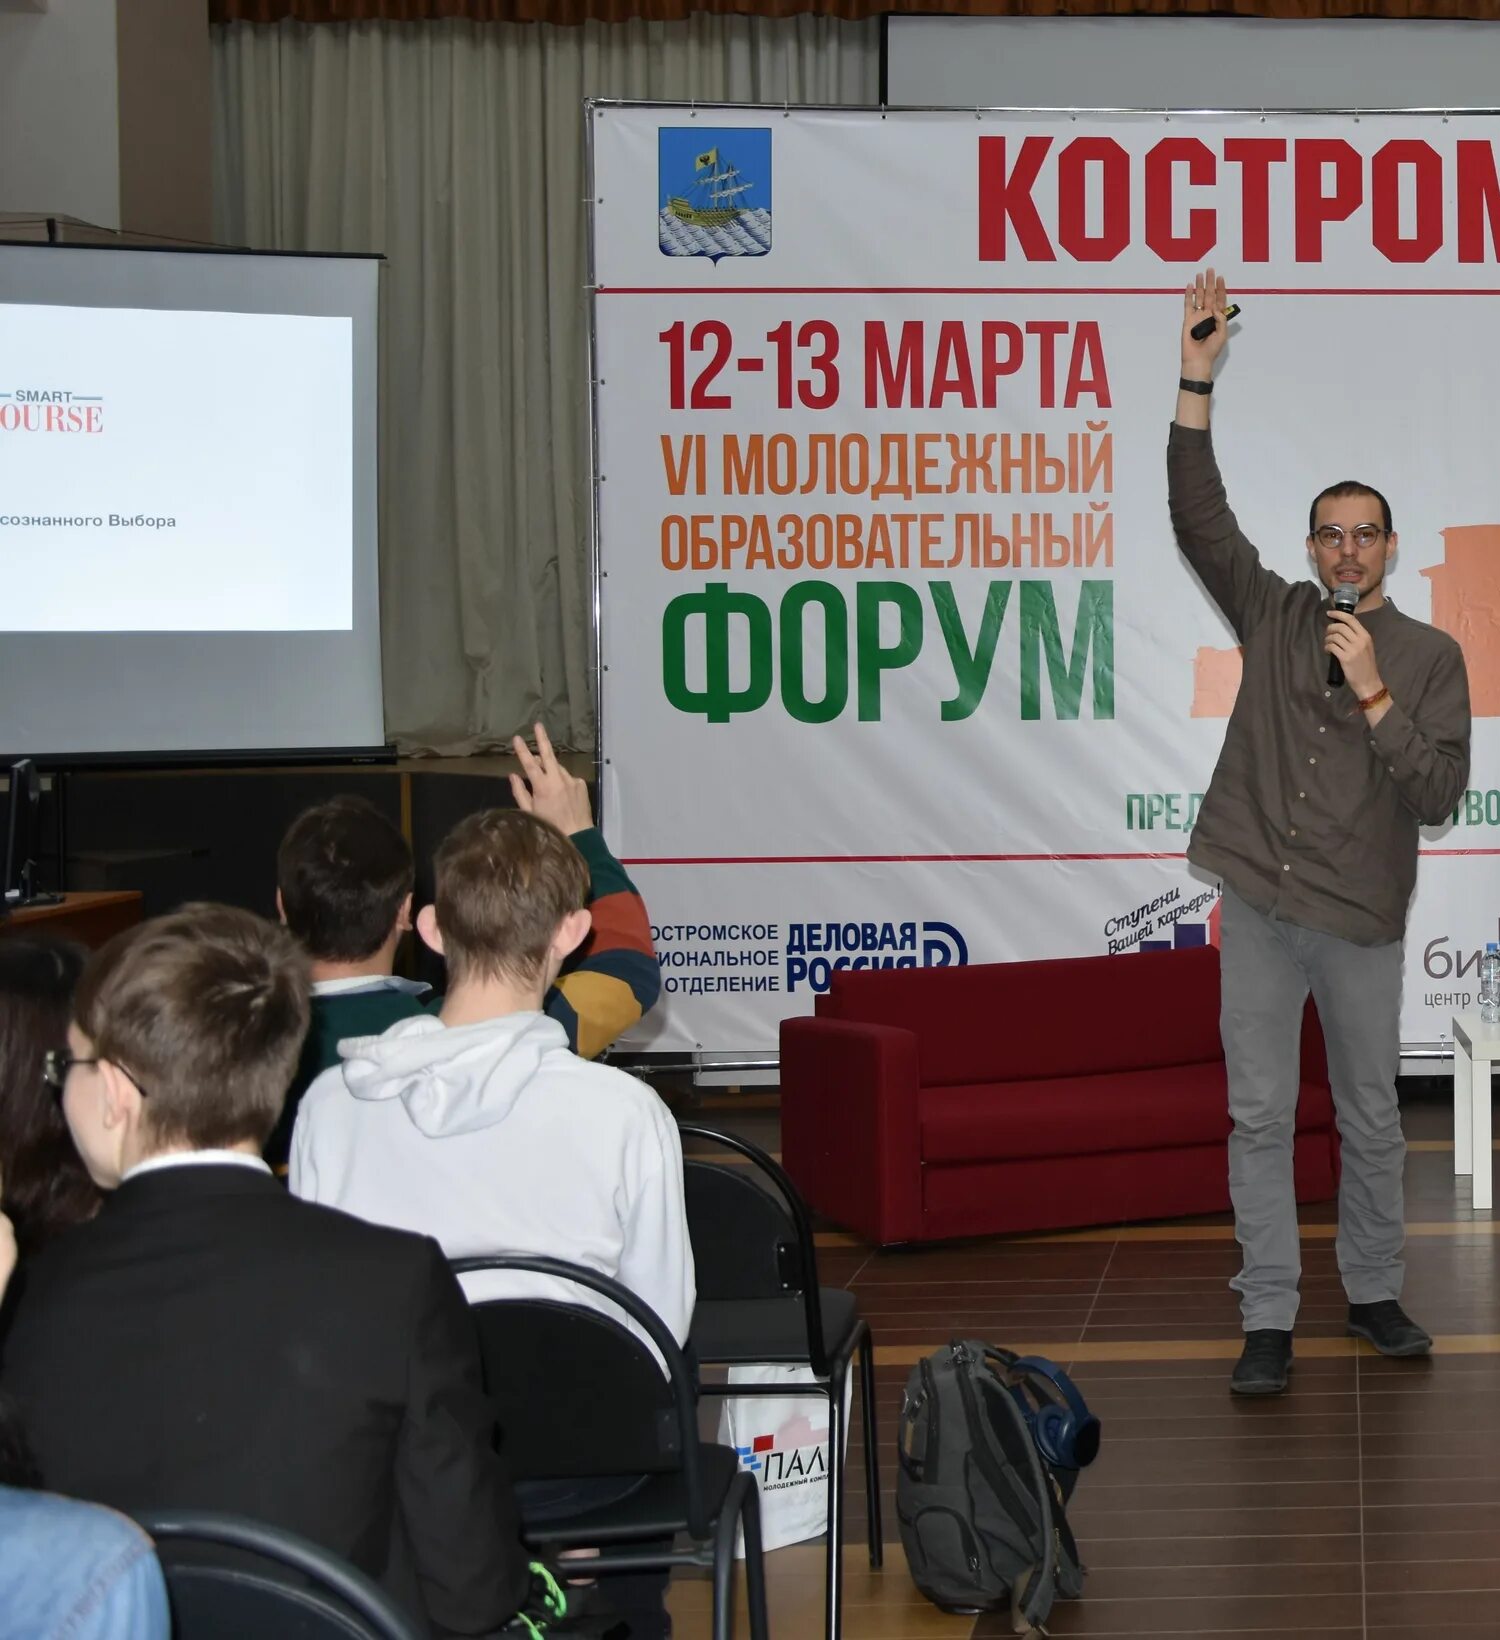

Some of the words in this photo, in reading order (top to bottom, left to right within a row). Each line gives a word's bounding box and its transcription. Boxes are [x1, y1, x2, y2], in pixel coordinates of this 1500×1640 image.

[659, 320, 839, 410] 12-13
[865, 321, 1112, 409] МАРТА
[16, 390, 73, 403] SMART
[0, 403, 104, 433] OURSE
[660, 434, 706, 496] VI
[722, 421, 1112, 501] МОЛОДЕЖНЫЙ
[0, 515, 103, 527] сознанного
[108, 514, 176, 529] Выбора
[661, 502, 1112, 571] ОБРАЗОВАТЕЛЬНЫЙ
[662, 580, 1114, 724] ФОРУМ
[1104, 887, 1180, 938] Ступени
[651, 924, 779, 942] ОСТРОМСКОЕ
[786, 922, 917, 955] ДЕЛОВАЯ
[1107, 920, 1154, 957] Вашей
[655, 950, 779, 967] ИОНАЛЬНОЕ
[664, 976, 780, 996] ОТДЕЛЕНИЕ
[1424, 991, 1471, 1009] центр
[764, 1446, 826, 1482] ПАЛ
